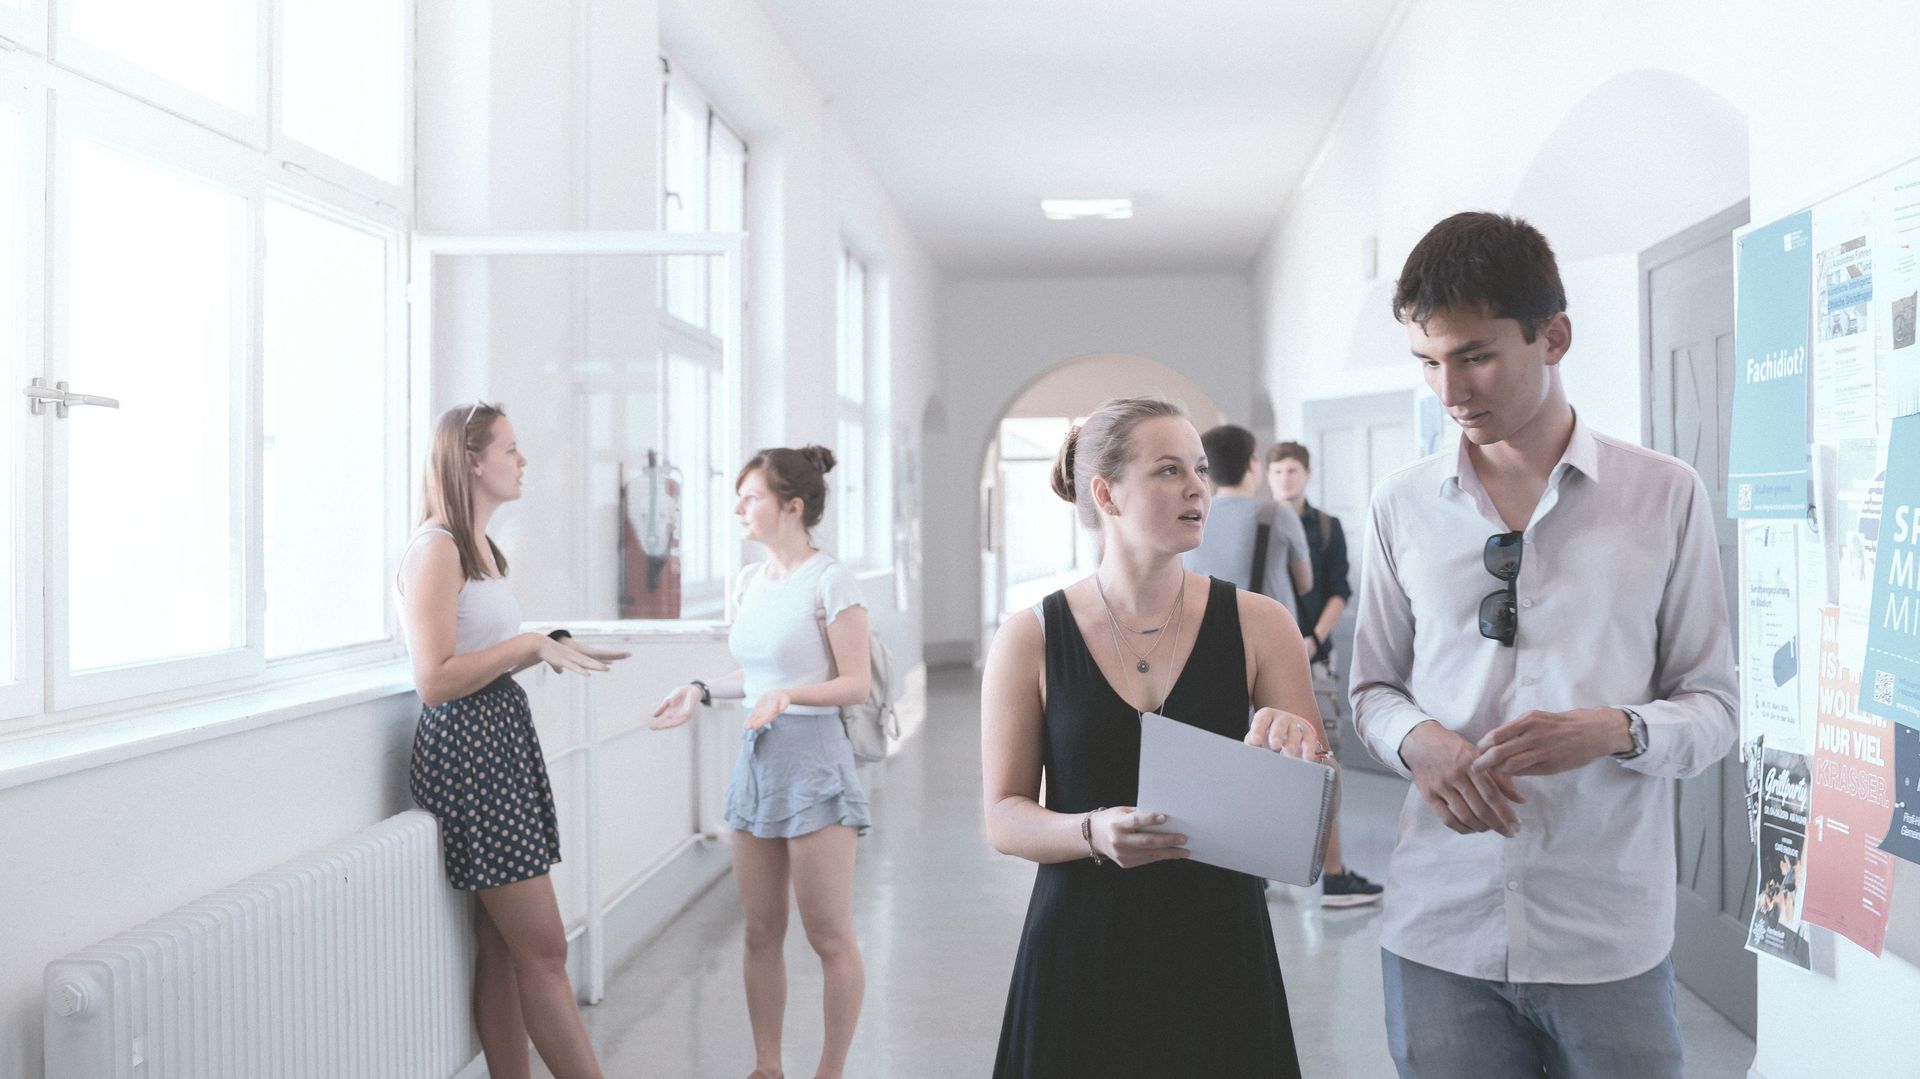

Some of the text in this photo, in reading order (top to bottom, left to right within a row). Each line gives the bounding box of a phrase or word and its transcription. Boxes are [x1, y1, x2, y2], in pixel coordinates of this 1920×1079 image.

[1747, 346, 1804, 384] Fachidiot?
[1818, 723, 1885, 767] NUR VIEL
[1764, 767, 1807, 812] Grillparty
[1816, 758, 1889, 808] KRASSER.
